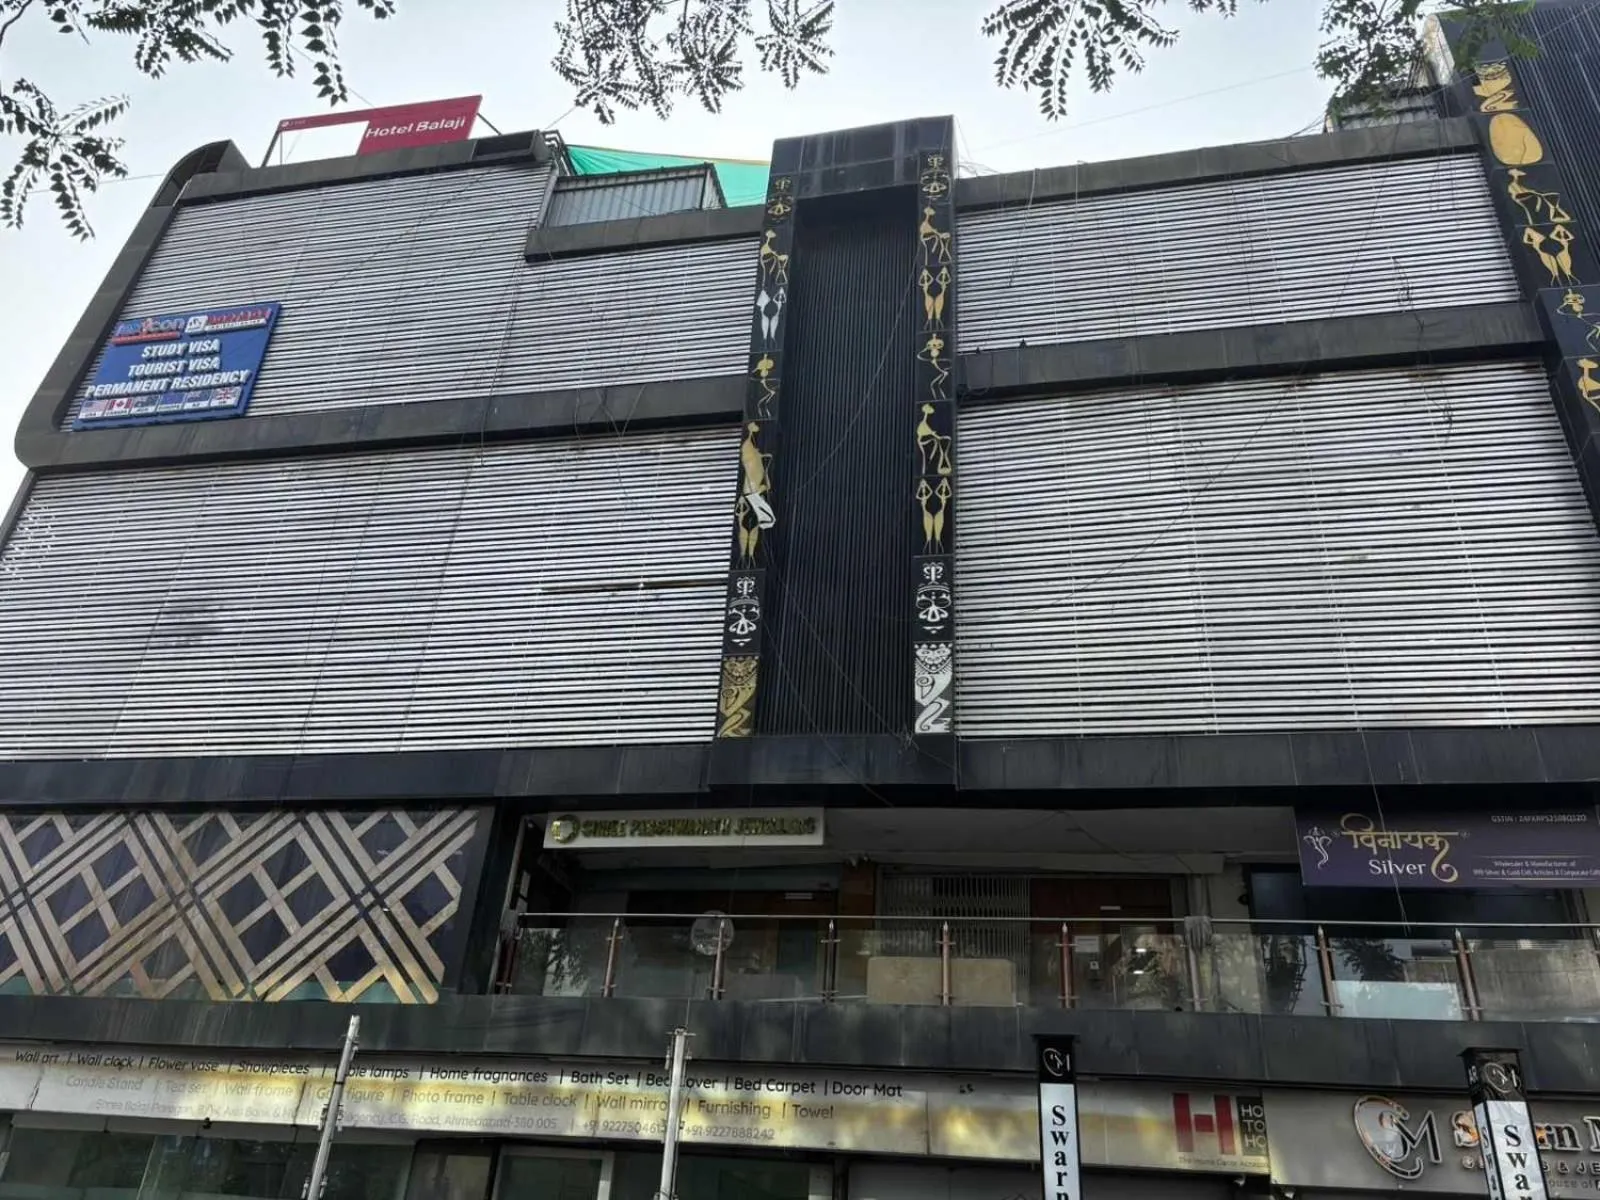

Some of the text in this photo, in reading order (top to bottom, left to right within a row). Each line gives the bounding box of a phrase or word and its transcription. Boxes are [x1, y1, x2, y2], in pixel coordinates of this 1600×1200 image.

[365, 117, 466, 139] Hotel Balaji
[141, 339, 221, 358] STUDY VISA
[128, 356, 221, 377] TOURIST VISA
[85, 369, 250, 398] PERMANENT RESIDENCY
[1368, 859, 1427, 876] Silver
[15, 1050, 40, 1063] Wall
[42, 1053, 60, 1064] art
[77, 1054, 102, 1066] Wall
[103, 1055, 134, 1069] clock
[149, 1057, 189, 1072] Flower
[191, 1060, 219, 1073] vase
[237, 1060, 310, 1077] Showpieces
[369, 1065, 410, 1081] lamps
[430, 1067, 469, 1081] Home
[472, 1067, 548, 1085] fragnances
[571, 1070, 603, 1084] Bath
[606, 1071, 630, 1085] Set
[681, 1076, 718, 1088] over
[735, 1076, 763, 1091] Bed
[766, 1078, 816, 1095] Carpet
[832, 1080, 869, 1095] Door
[873, 1083, 903, 1098] Mat
[402, 1088, 442, 1103] Photo
[443, 1089, 485, 1105] frame
[504, 1091, 539, 1107] Table
[541, 1092, 578, 1108] clock
[597, 1094, 626, 1110] Wall
[629, 1096, 668, 1111] mirro
[698, 1099, 771, 1118] Furnishing
[792, 1104, 834, 1119] Towel
